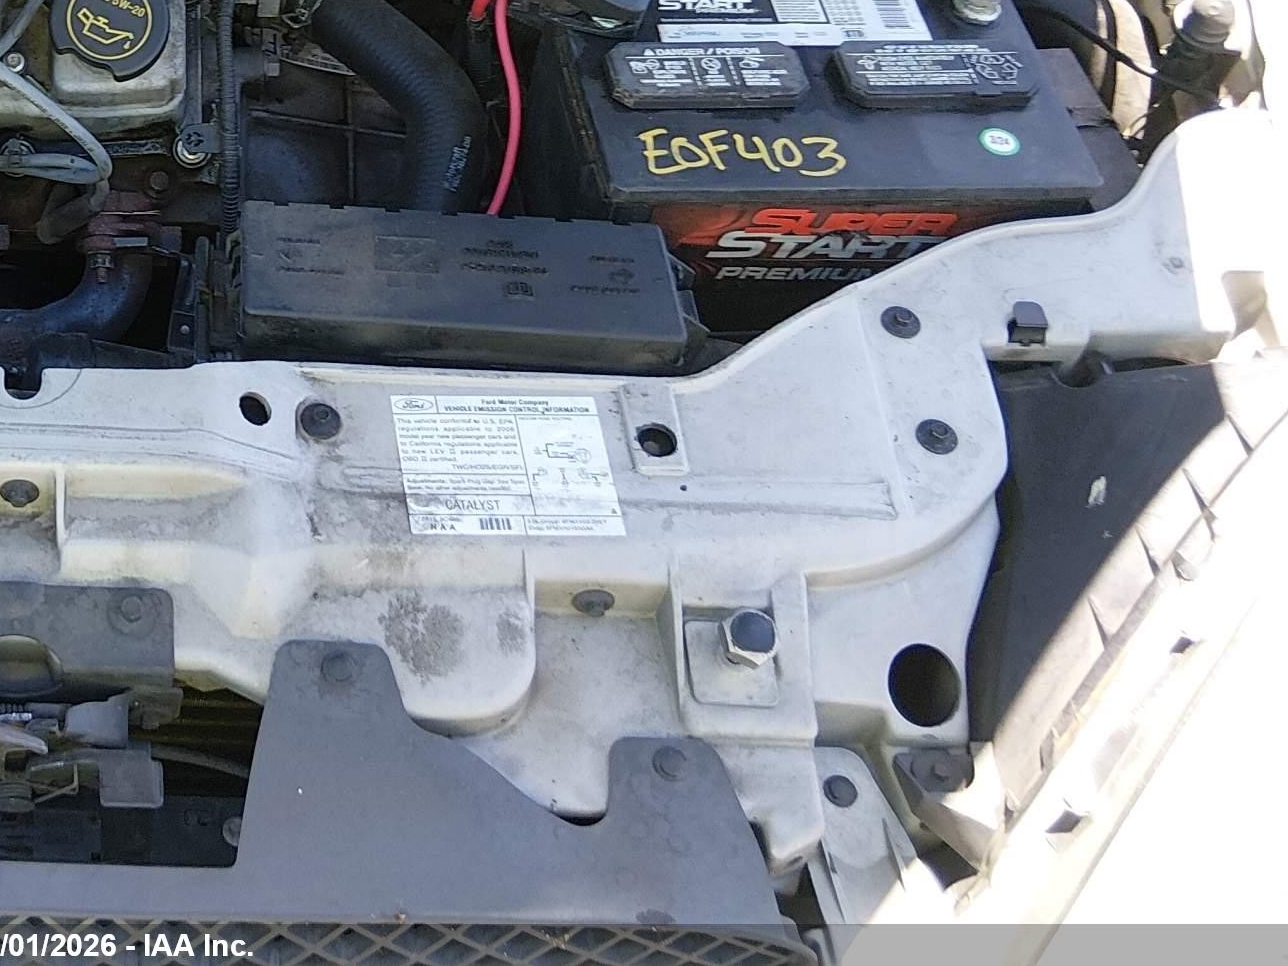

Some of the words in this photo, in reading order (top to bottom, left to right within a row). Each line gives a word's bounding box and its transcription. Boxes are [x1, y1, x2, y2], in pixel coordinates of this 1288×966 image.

[655, 47, 705, 56] DANGER
[715, 47, 761, 55] POISON
[743, 207, 960, 236] SUPER
[704, 230, 951, 260] START
[402, 400, 426, 410] Ford
[518, 399, 550, 407] Company
[445, 499, 501, 511] CATALYST
